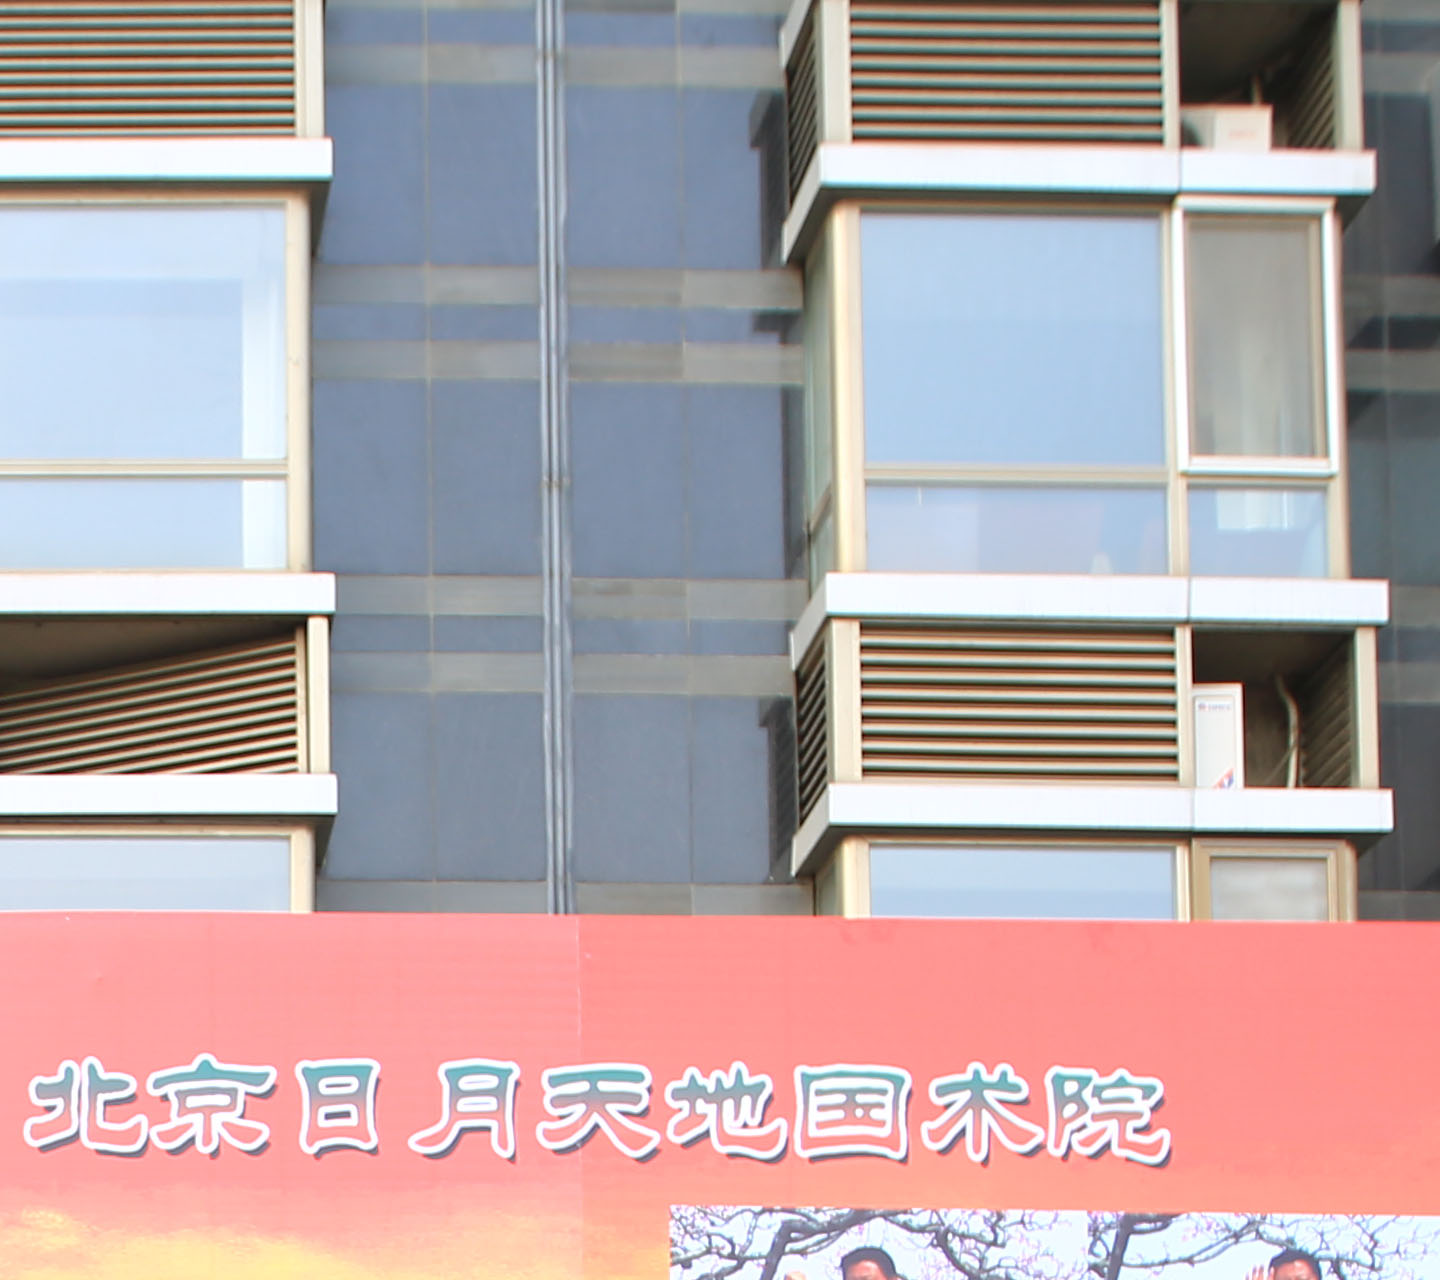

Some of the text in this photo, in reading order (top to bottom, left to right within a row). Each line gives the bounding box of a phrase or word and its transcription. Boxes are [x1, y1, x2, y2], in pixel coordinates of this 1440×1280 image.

[23, 1053, 1172, 1166] 北京日月天地国术院
